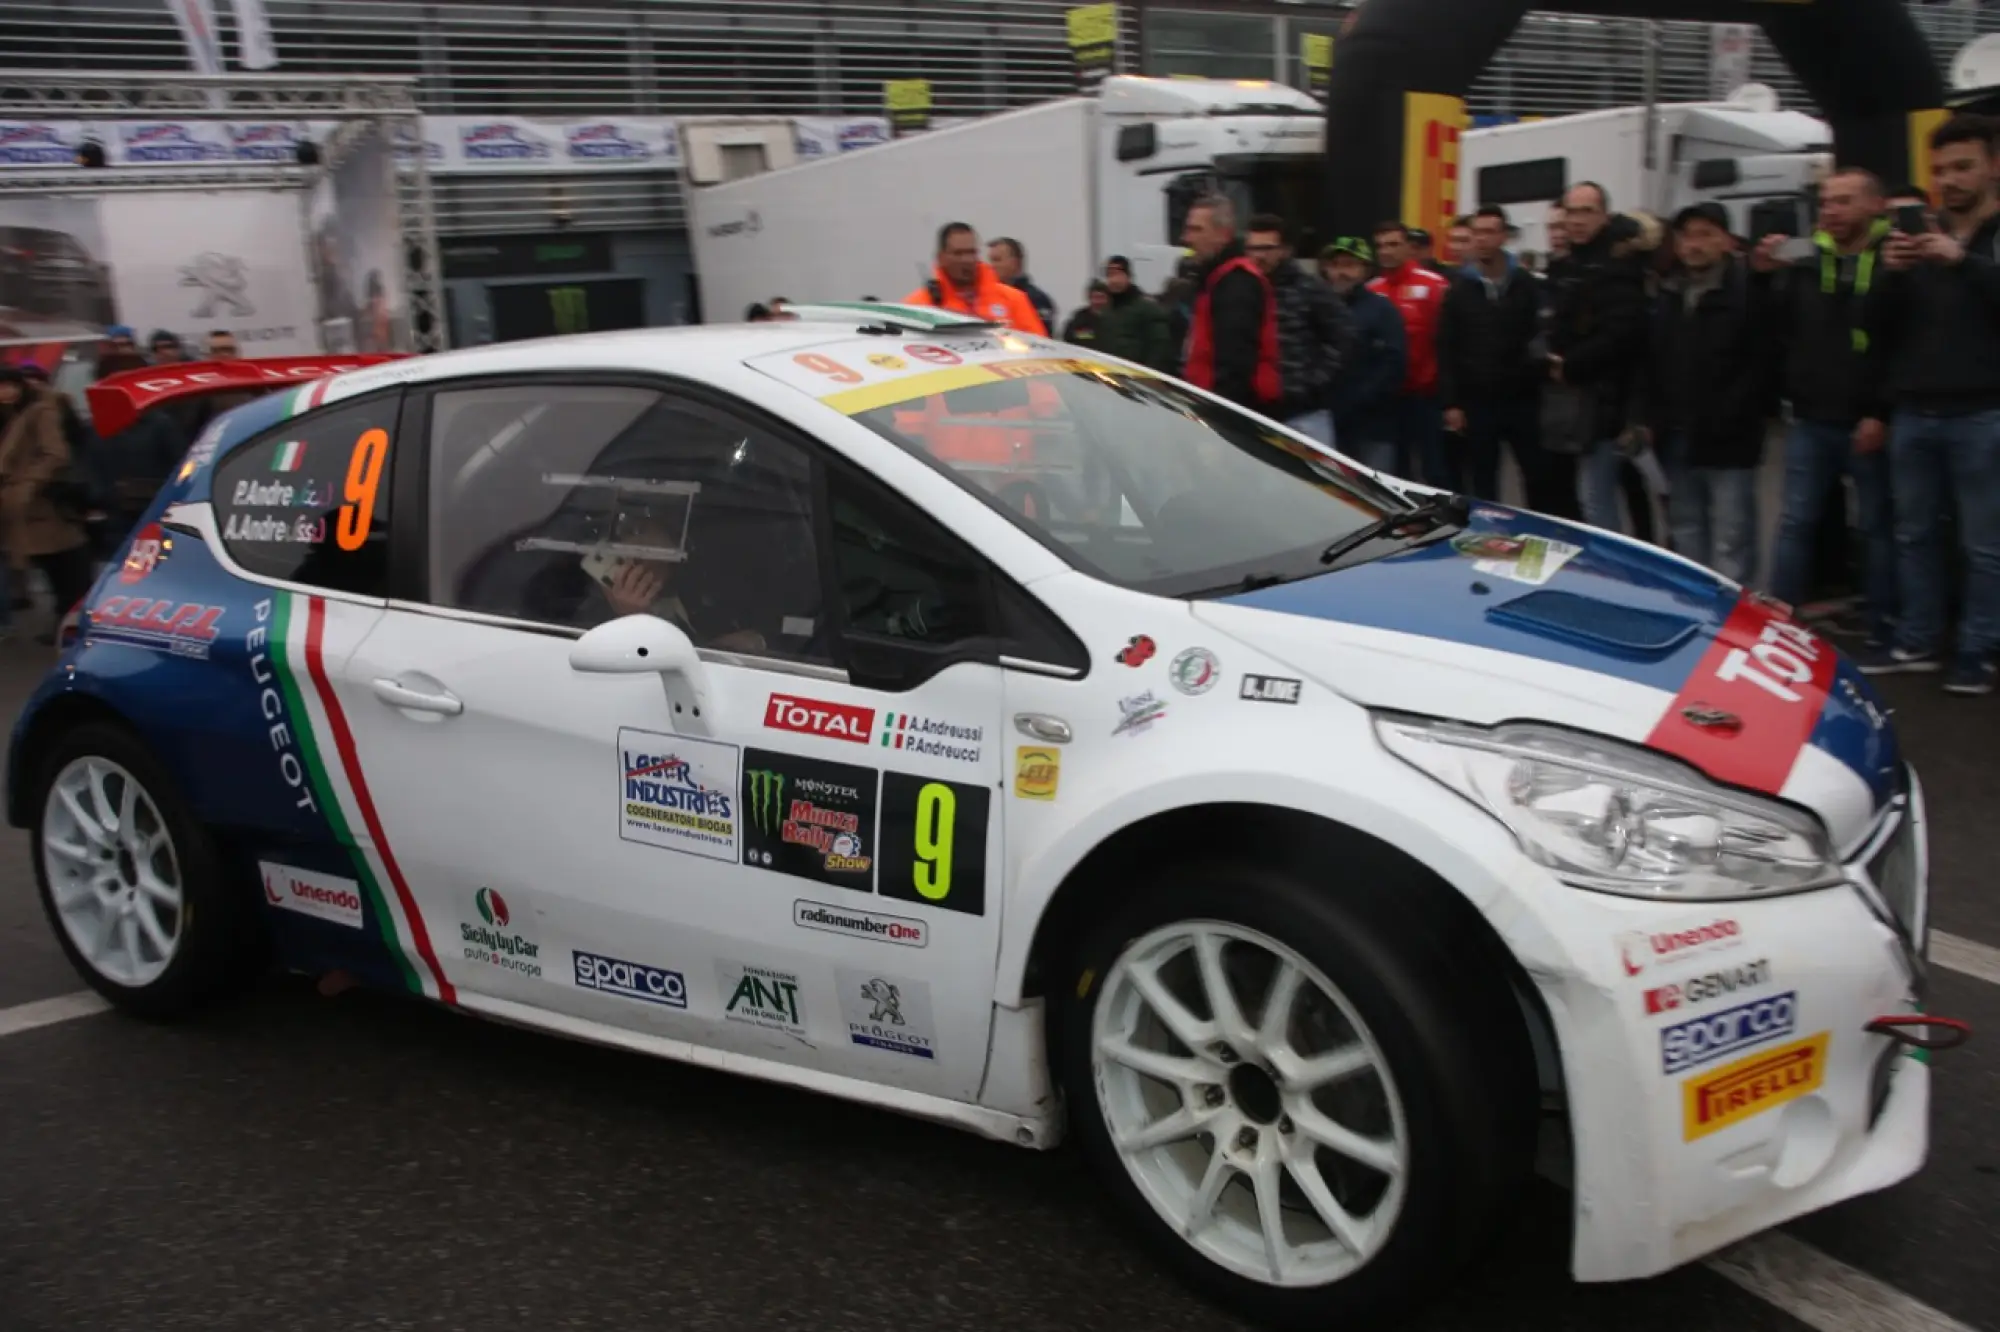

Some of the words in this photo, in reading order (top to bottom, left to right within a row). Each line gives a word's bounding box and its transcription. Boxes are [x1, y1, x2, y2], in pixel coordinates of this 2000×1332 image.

[793, 353, 864, 383] 9
[336, 428, 389, 551] 9
[1714, 619, 1820, 702] TOTA
[246, 598, 318, 813] PEUGEOT
[772, 699, 867, 738] TOTAL
[908, 715, 984, 743] A.Andreussi
[906, 735, 980, 764] P.Andreucci
[794, 776, 859, 800] MONSTER
[782, 819, 834, 854] Rally
[913, 782, 957, 900] 9
[825, 853, 872, 871] Show
[289, 877, 358, 910] Unendo
[460, 922, 497, 952] Sicily
[513, 935, 539, 958] Car
[1652, 919, 1741, 954] Unendo
[577, 953, 684, 999] sparco
[726, 975, 799, 1025] ANT
[1663, 997, 1794, 1063] sparco
[1695, 1046, 1816, 1125] PIRELLI
